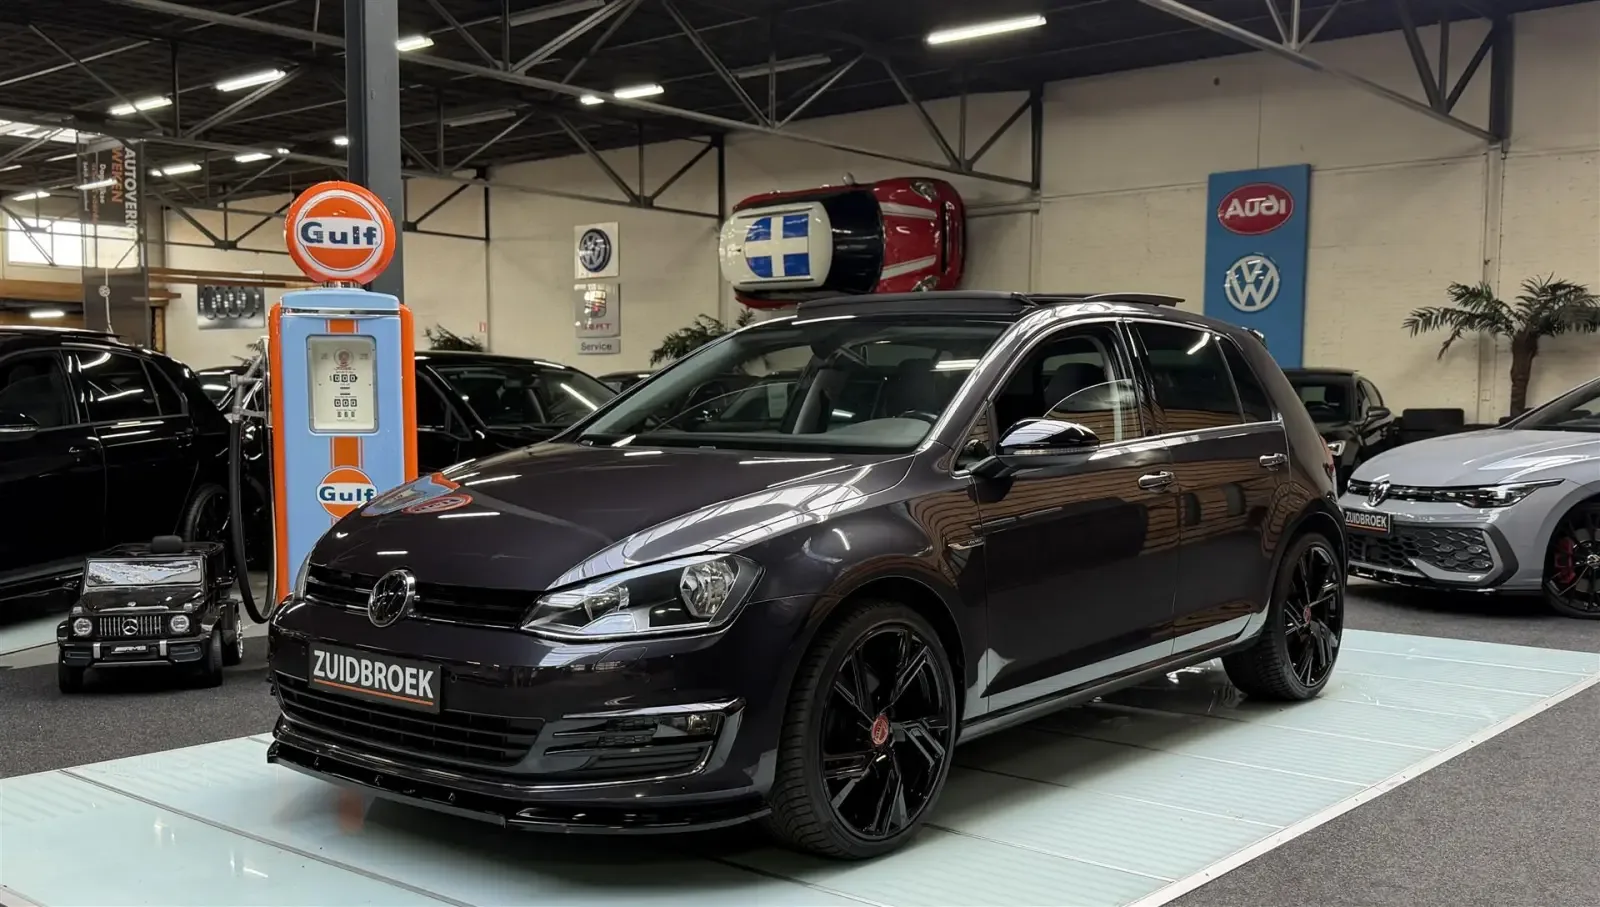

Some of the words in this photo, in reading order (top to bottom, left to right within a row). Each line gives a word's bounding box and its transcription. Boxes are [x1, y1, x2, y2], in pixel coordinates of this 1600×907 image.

[301, 221, 377, 245] Gulf
[581, 342, 612, 351] Service
[319, 486, 374, 501] Gulf
[1345, 511, 1387, 528] ZUIDBROEK
[313, 650, 434, 699] ZUIDBROEK
